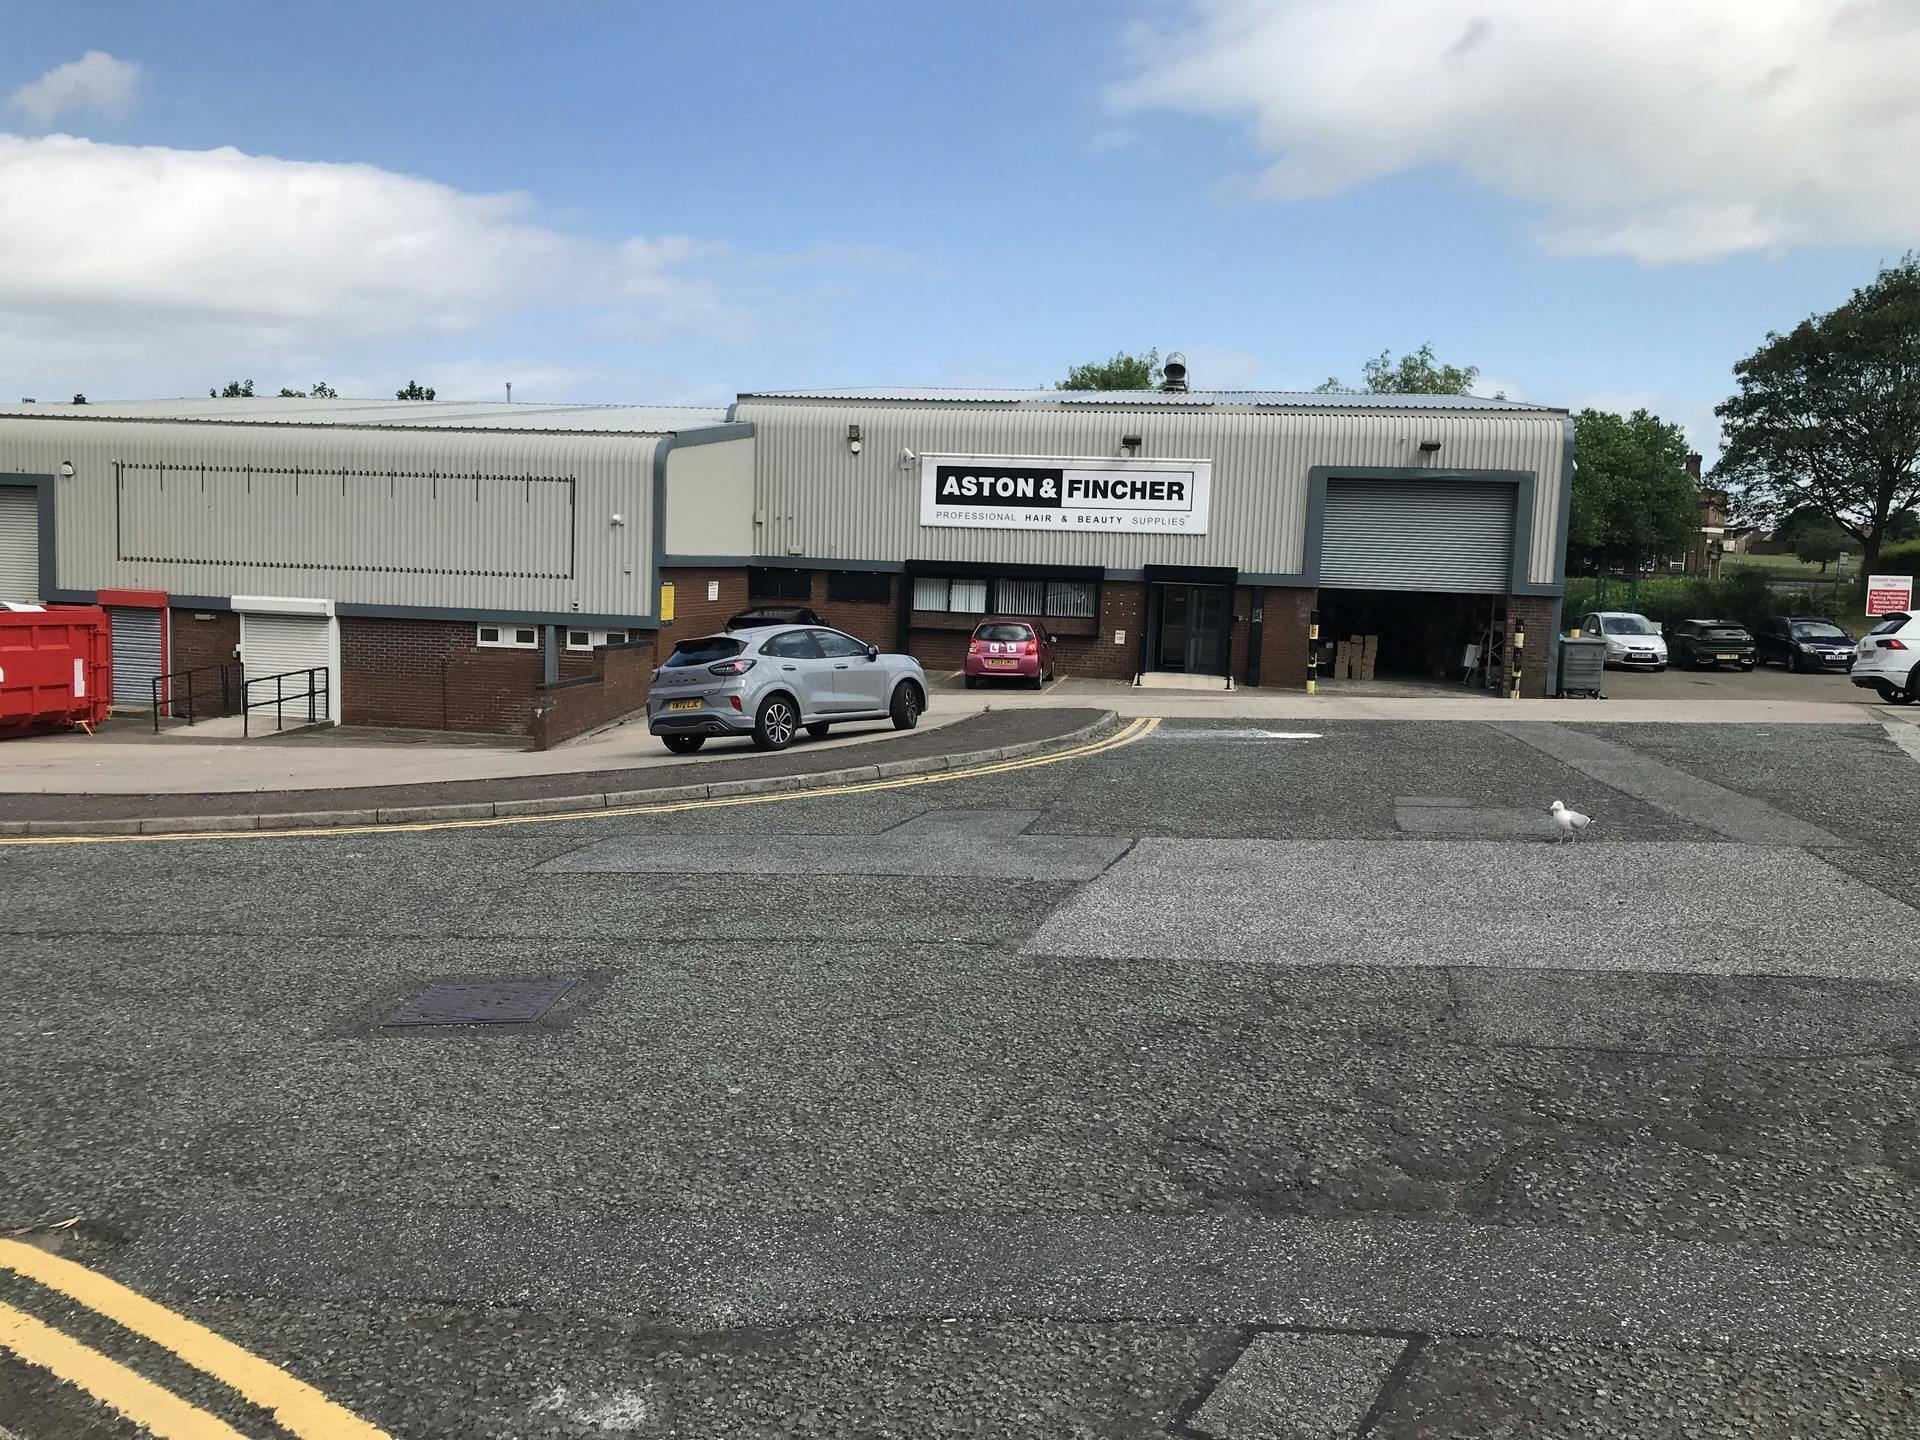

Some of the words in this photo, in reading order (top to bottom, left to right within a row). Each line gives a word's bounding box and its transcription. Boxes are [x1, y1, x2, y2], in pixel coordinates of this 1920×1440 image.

[942, 476, 1034, 498] ASTON
[1039, 479, 1058, 498] &
[1067, 479, 1184, 501] FINCHER
[936, 511, 1016, 522] PROFESSIONAL
[1025, 514, 1052, 523] HAIR
[1061, 515, 1068, 523] &
[1077, 515, 1123, 525] BEAUTY
[1132, 516, 1186, 526] SUPPLIES
